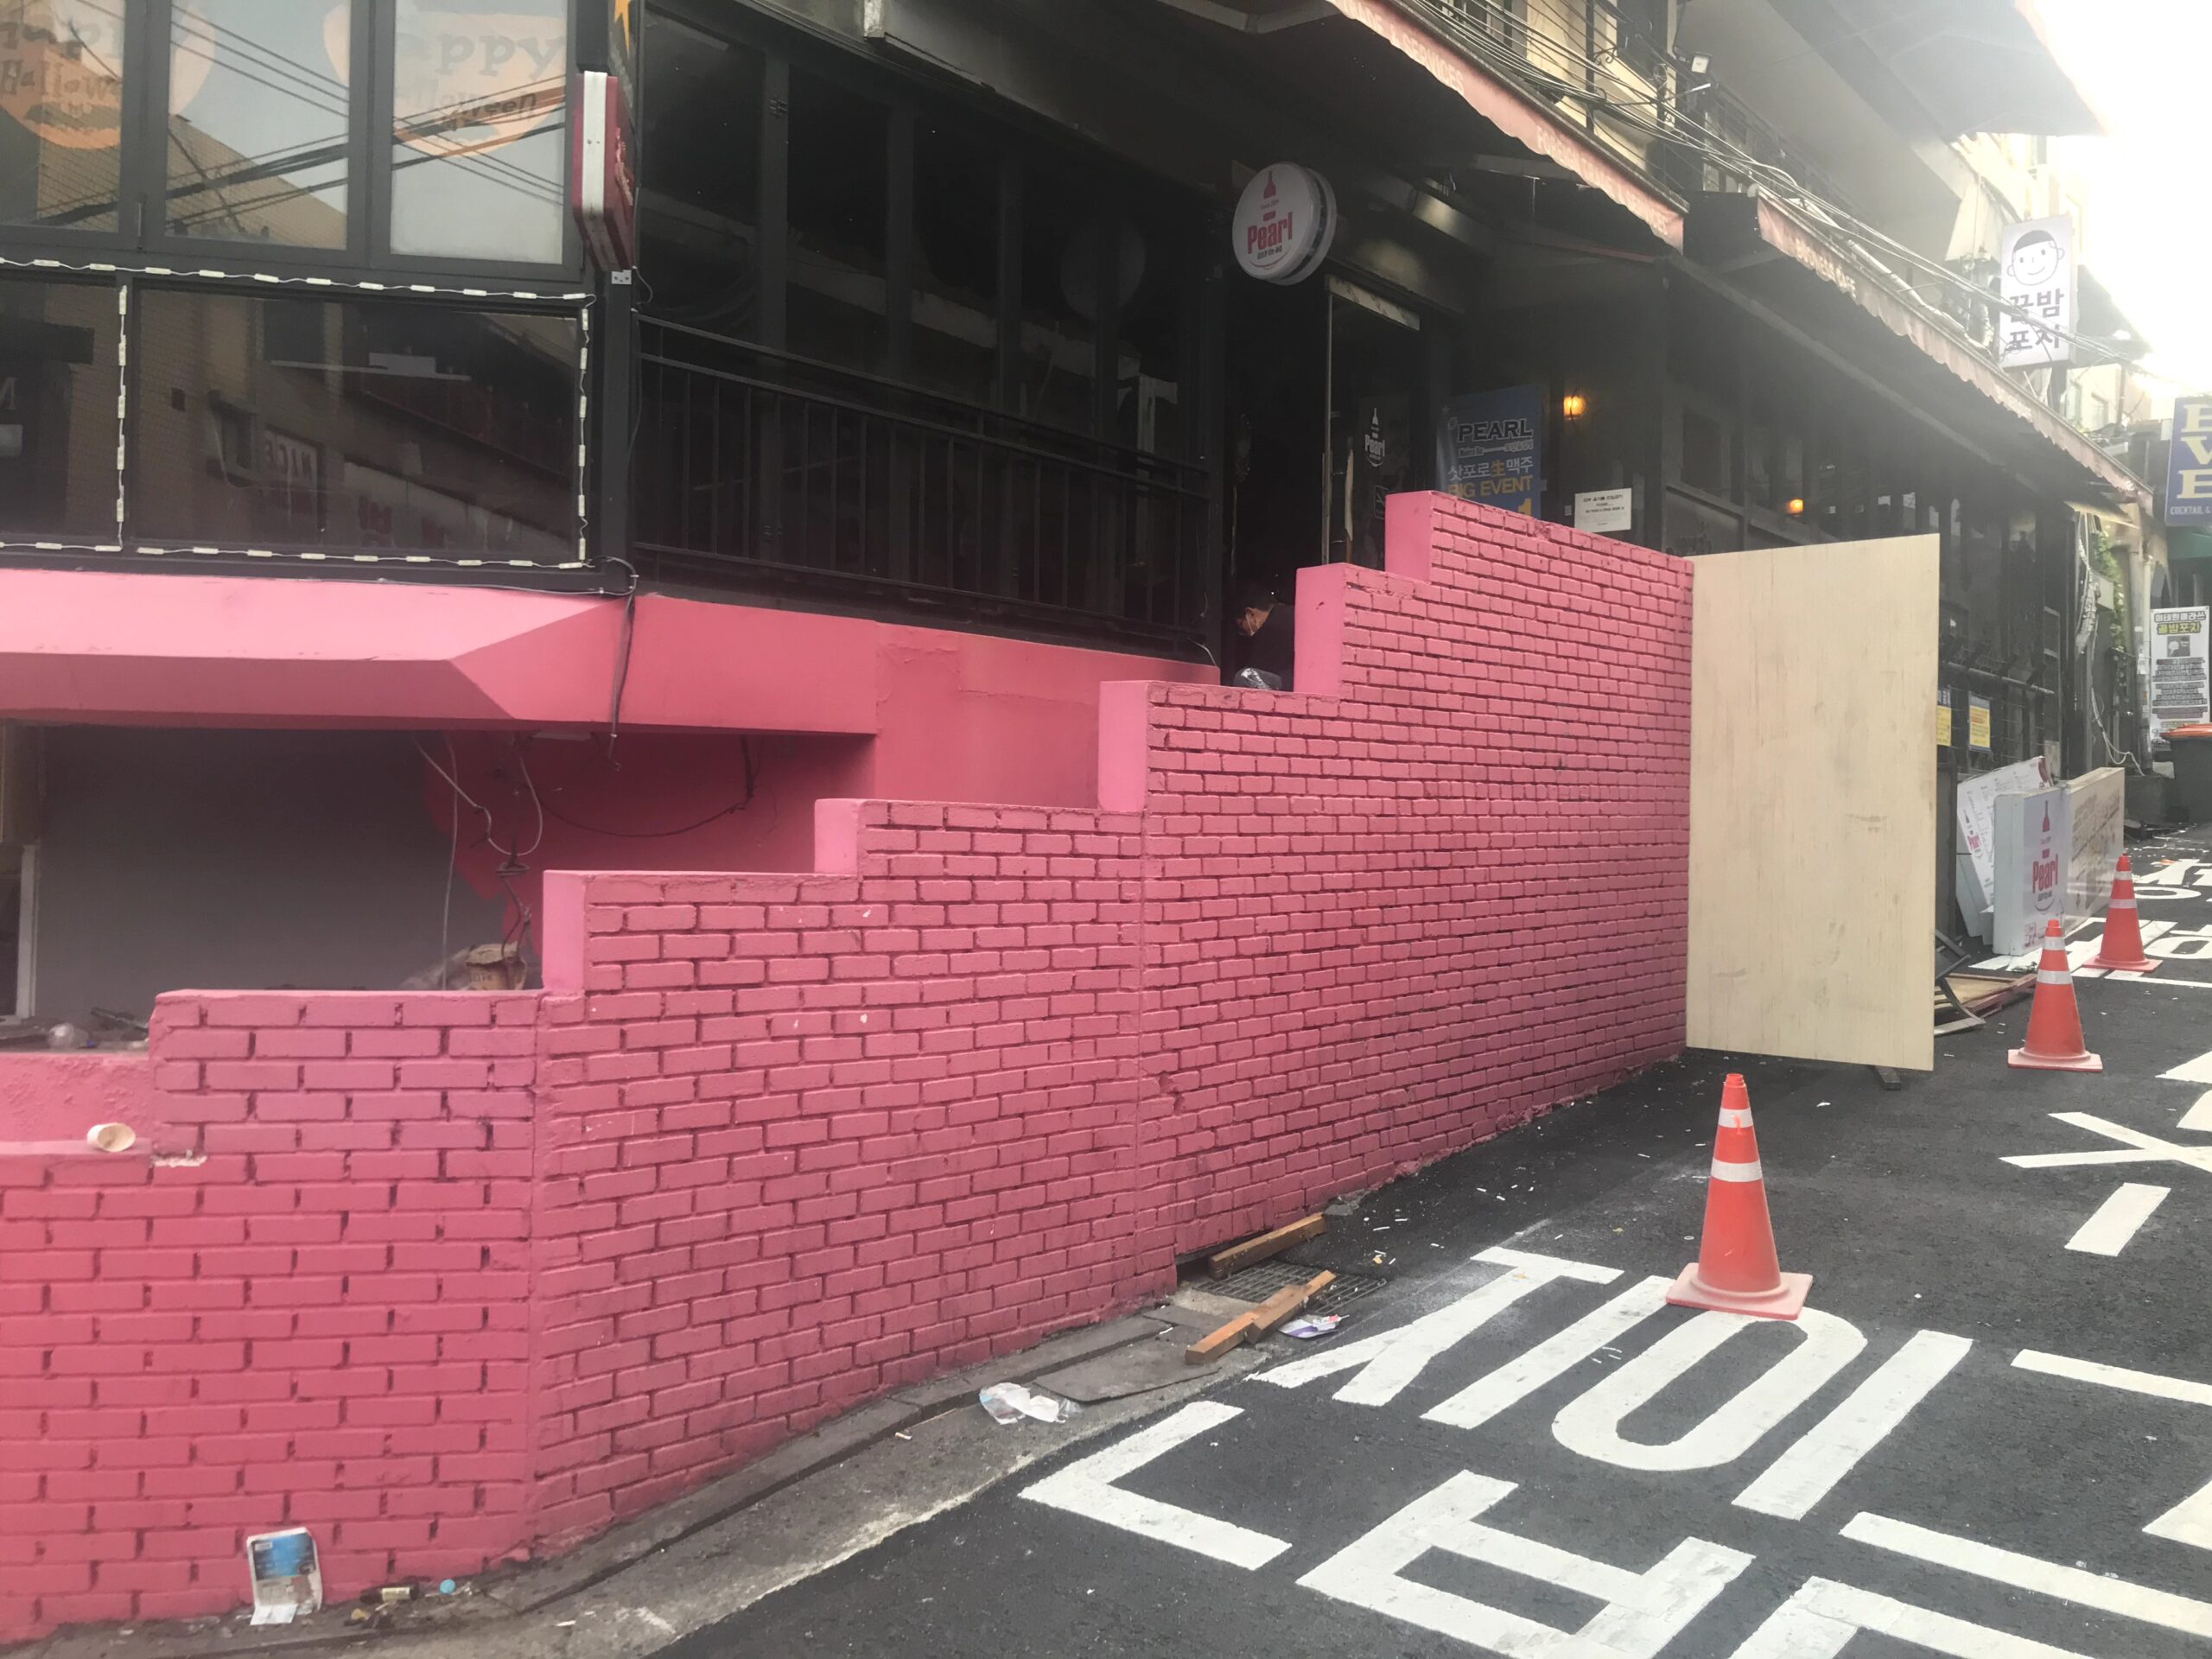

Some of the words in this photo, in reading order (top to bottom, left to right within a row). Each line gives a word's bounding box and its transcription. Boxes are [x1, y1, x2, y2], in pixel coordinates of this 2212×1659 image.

[1248, 212, 1293, 254] Pearl
[1458, 417, 1534, 442] PEARL
[1364, 434, 1385, 457] Pearl
[1448, 484, 1476, 498] BIG
[1481, 475, 1533, 496] EVENT
[2031, 853, 2058, 893] Pearl
